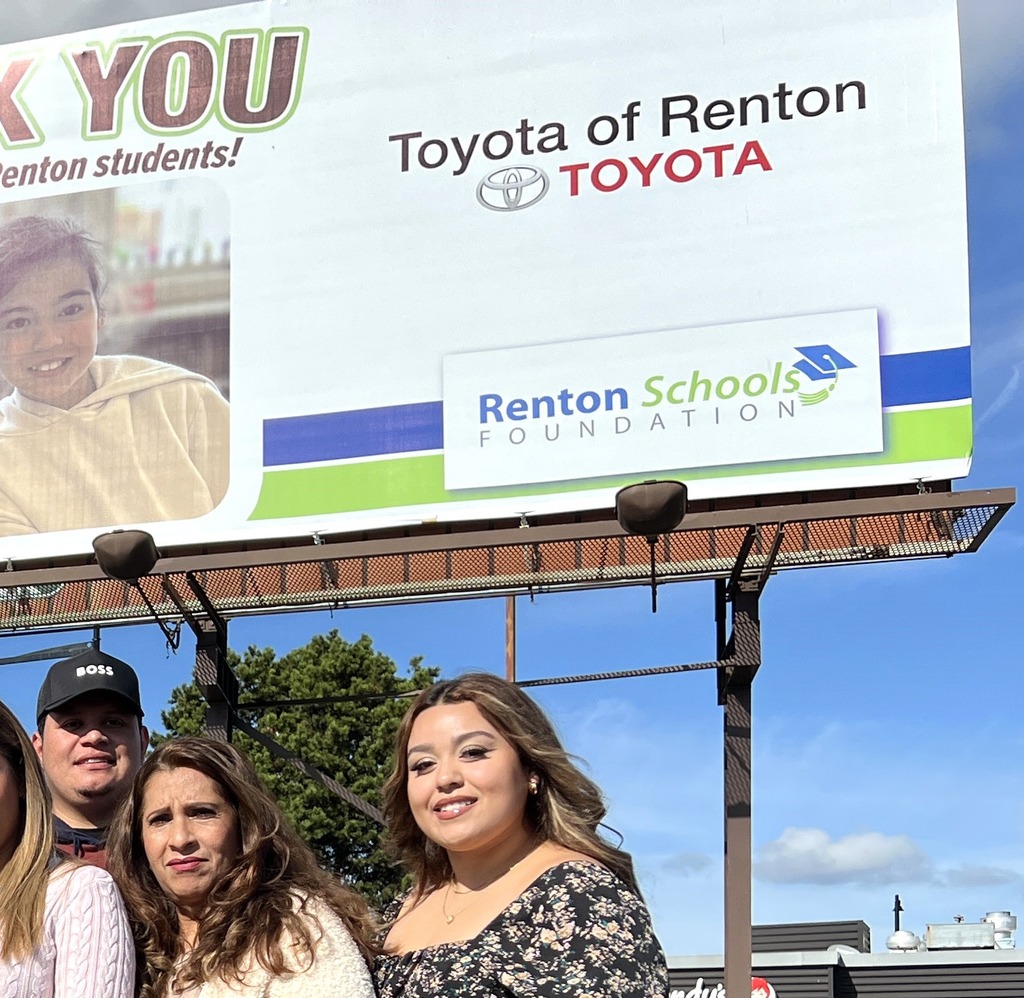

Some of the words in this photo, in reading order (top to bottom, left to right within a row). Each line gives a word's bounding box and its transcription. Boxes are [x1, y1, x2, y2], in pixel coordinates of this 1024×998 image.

[72, 35, 300, 133] YOU
[389, 118, 568, 177] Toyota
[587, 101, 640, 146] of
[662, 80, 866, 137] Renton
[93, 137, 244, 177] students!
[559, 140, 772, 196] TOYOTA
[480, 387, 629, 424] Renton
[641, 361, 801, 408] Schools
[480, 400, 795, 448] FOUNDATION
[76, 664, 114, 677] BOSS
